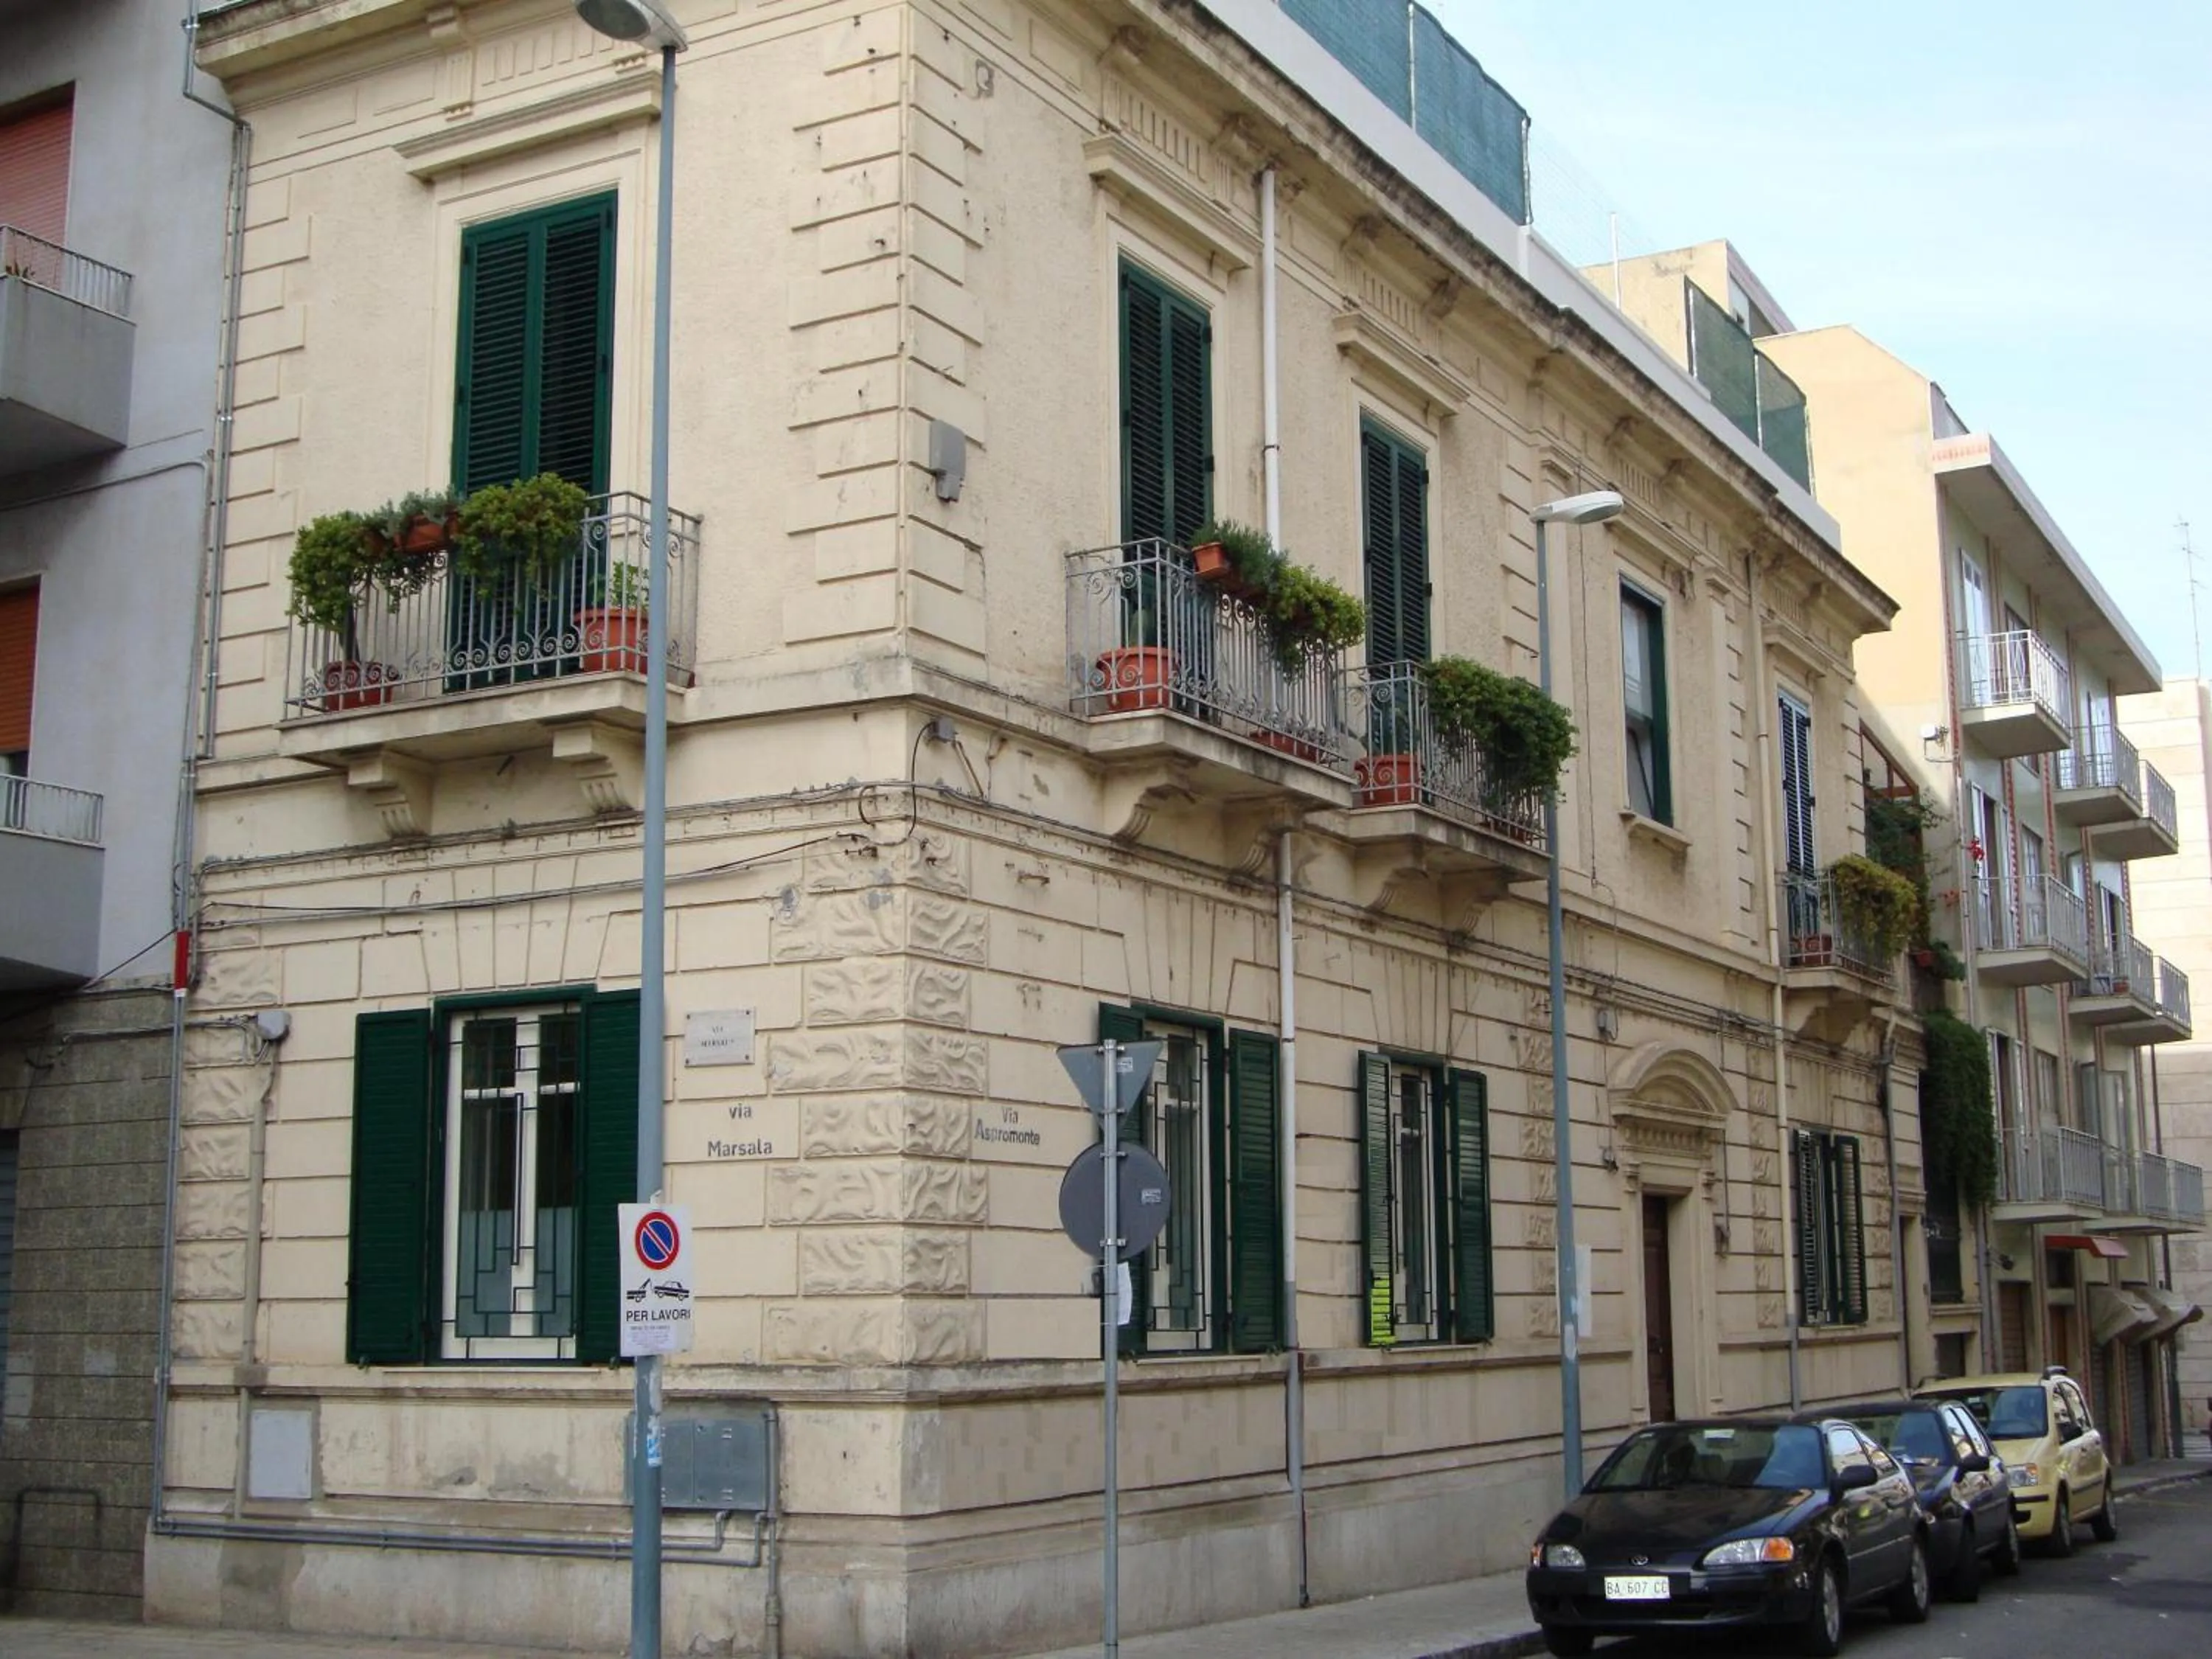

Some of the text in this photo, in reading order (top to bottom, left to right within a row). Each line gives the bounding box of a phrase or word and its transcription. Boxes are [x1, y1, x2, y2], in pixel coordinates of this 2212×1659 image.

[1002, 1107, 1018, 1124] Via
[974, 1117, 1040, 1145] Aspromonte
[708, 1138, 773, 1157] Marsala
[626, 1308, 691, 1321] PER LAVORI
[1607, 1582, 1620, 1595] BA
